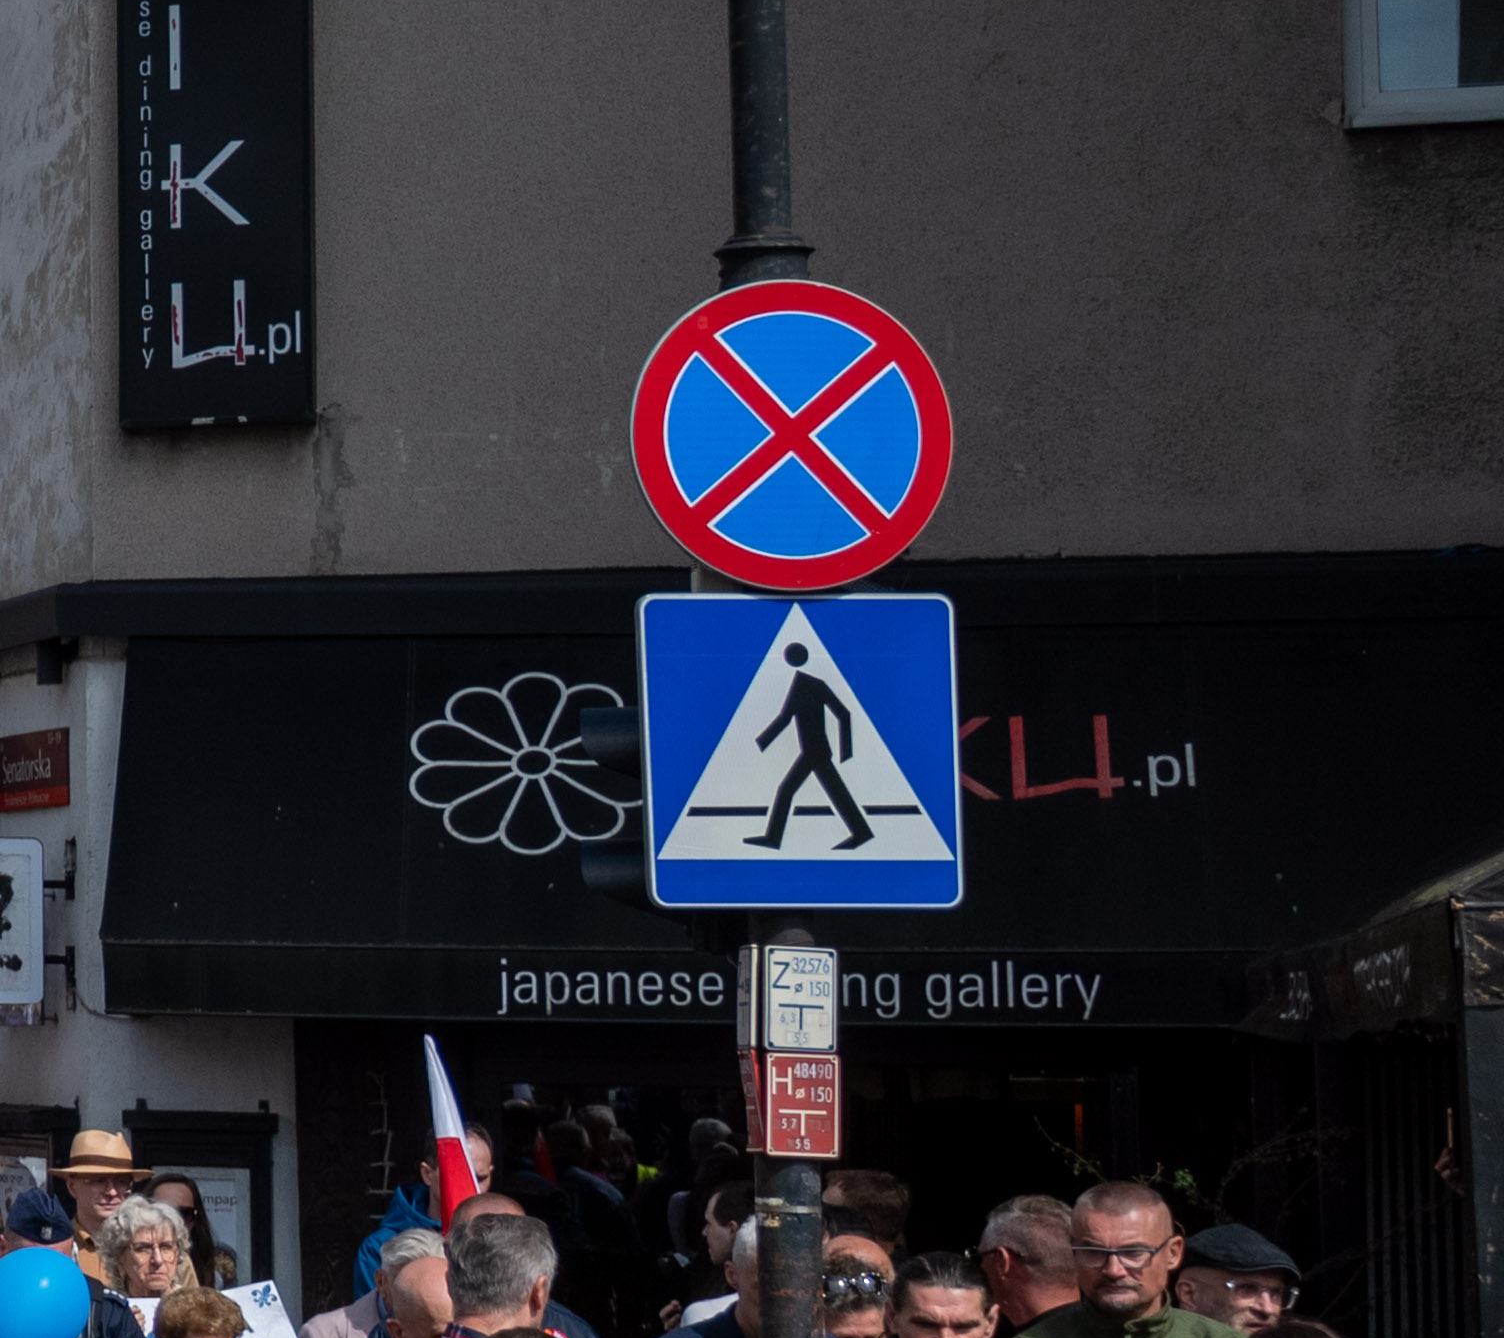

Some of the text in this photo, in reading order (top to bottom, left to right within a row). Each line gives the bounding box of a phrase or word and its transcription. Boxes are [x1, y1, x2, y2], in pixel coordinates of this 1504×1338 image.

[139, 55, 153, 190] dining
[140, 210, 155, 369] gallery
[2, 749, 52, 785] Senatorska
[497, 959, 725, 1016] japanese
[925, 960, 1102, 1020] gallery
[772, 957, 831, 989] Z 32576
[809, 980, 830, 997] 150
[772, 1063, 833, 1095] H 48490
[810, 1087, 833, 1103] 150
